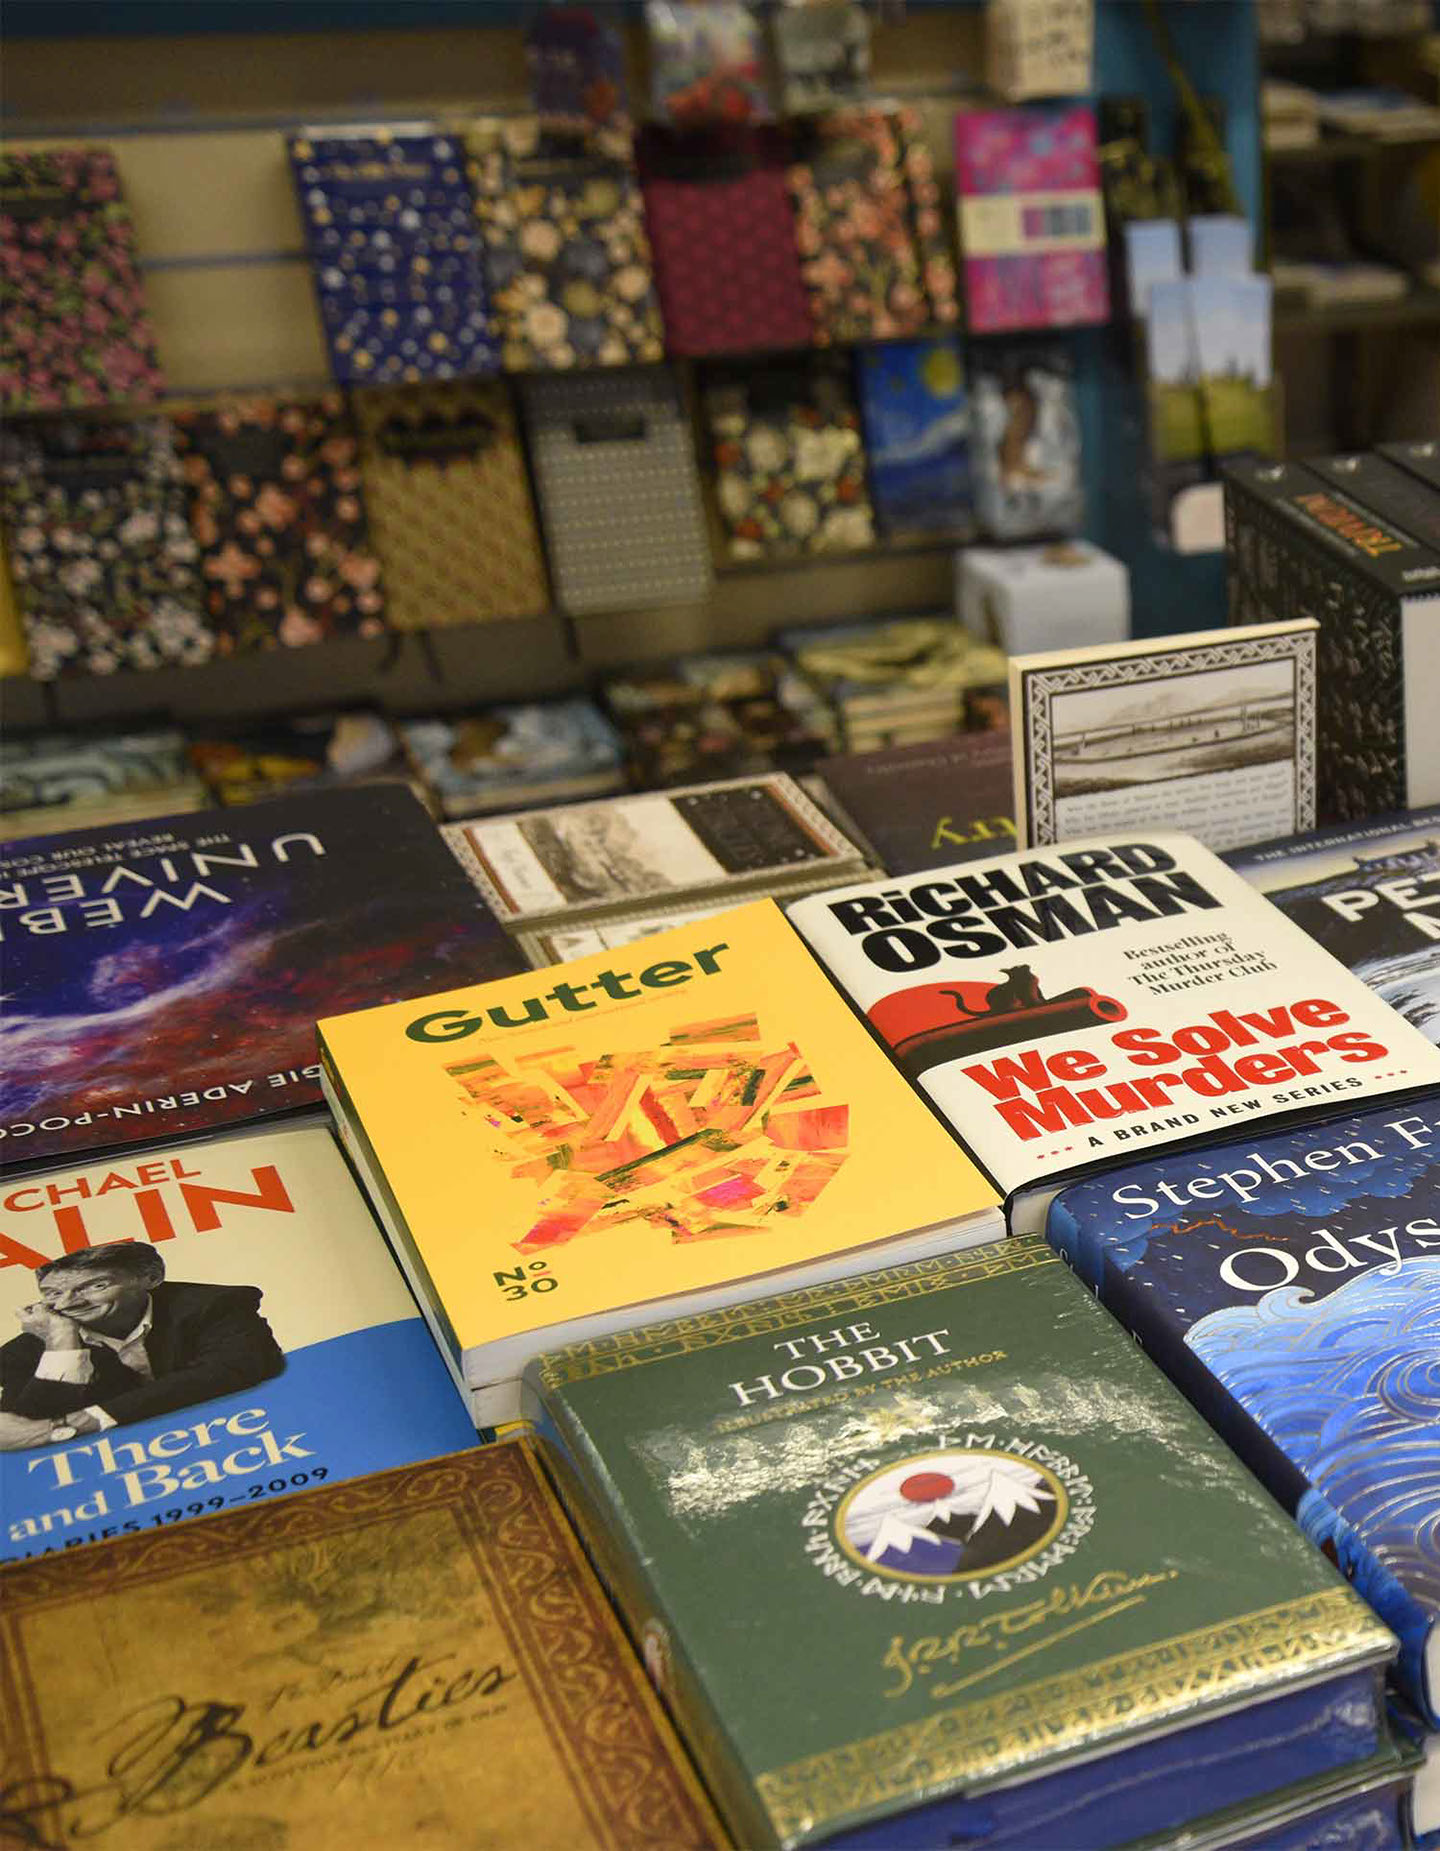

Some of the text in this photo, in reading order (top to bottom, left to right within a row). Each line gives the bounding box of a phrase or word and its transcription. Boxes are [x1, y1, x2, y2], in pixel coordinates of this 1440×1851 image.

[1255, 848, 1286, 862] THE
[1289, 823, 1411, 854] INTERNATIONAL
[0, 882, 233, 940] WEB
[860, 869, 1226, 974] OSMAN
[1123, 931, 1232, 961] Bestselling
[1127, 949, 1268, 986] The Thursday
[1140, 940, 1237, 971] author of
[404, 942, 733, 1045] Gutter
[1149, 958, 1278, 996] Murder Club
[959, 997, 1352, 1101] We Solve
[0, 1079, 254, 1140] ADERIN-POC
[993, 1029, 1390, 1141] Murders
[1087, 1076, 1365, 1148] A BRAND NEW SERIES
[1112, 1138, 1384, 1221] Stephen
[501, 1277, 559, 1303] 30
[729, 1329, 951, 1407] HOBBIT
[774, 1322, 881, 1360] THE
[854, 1383, 878, 1399] BY
[881, 1370, 922, 1390] THE
[923, 1350, 1008, 1379] AUTHOR
[28, 1407, 270, 1492] There
[9, 1431, 317, 1544] and Back
